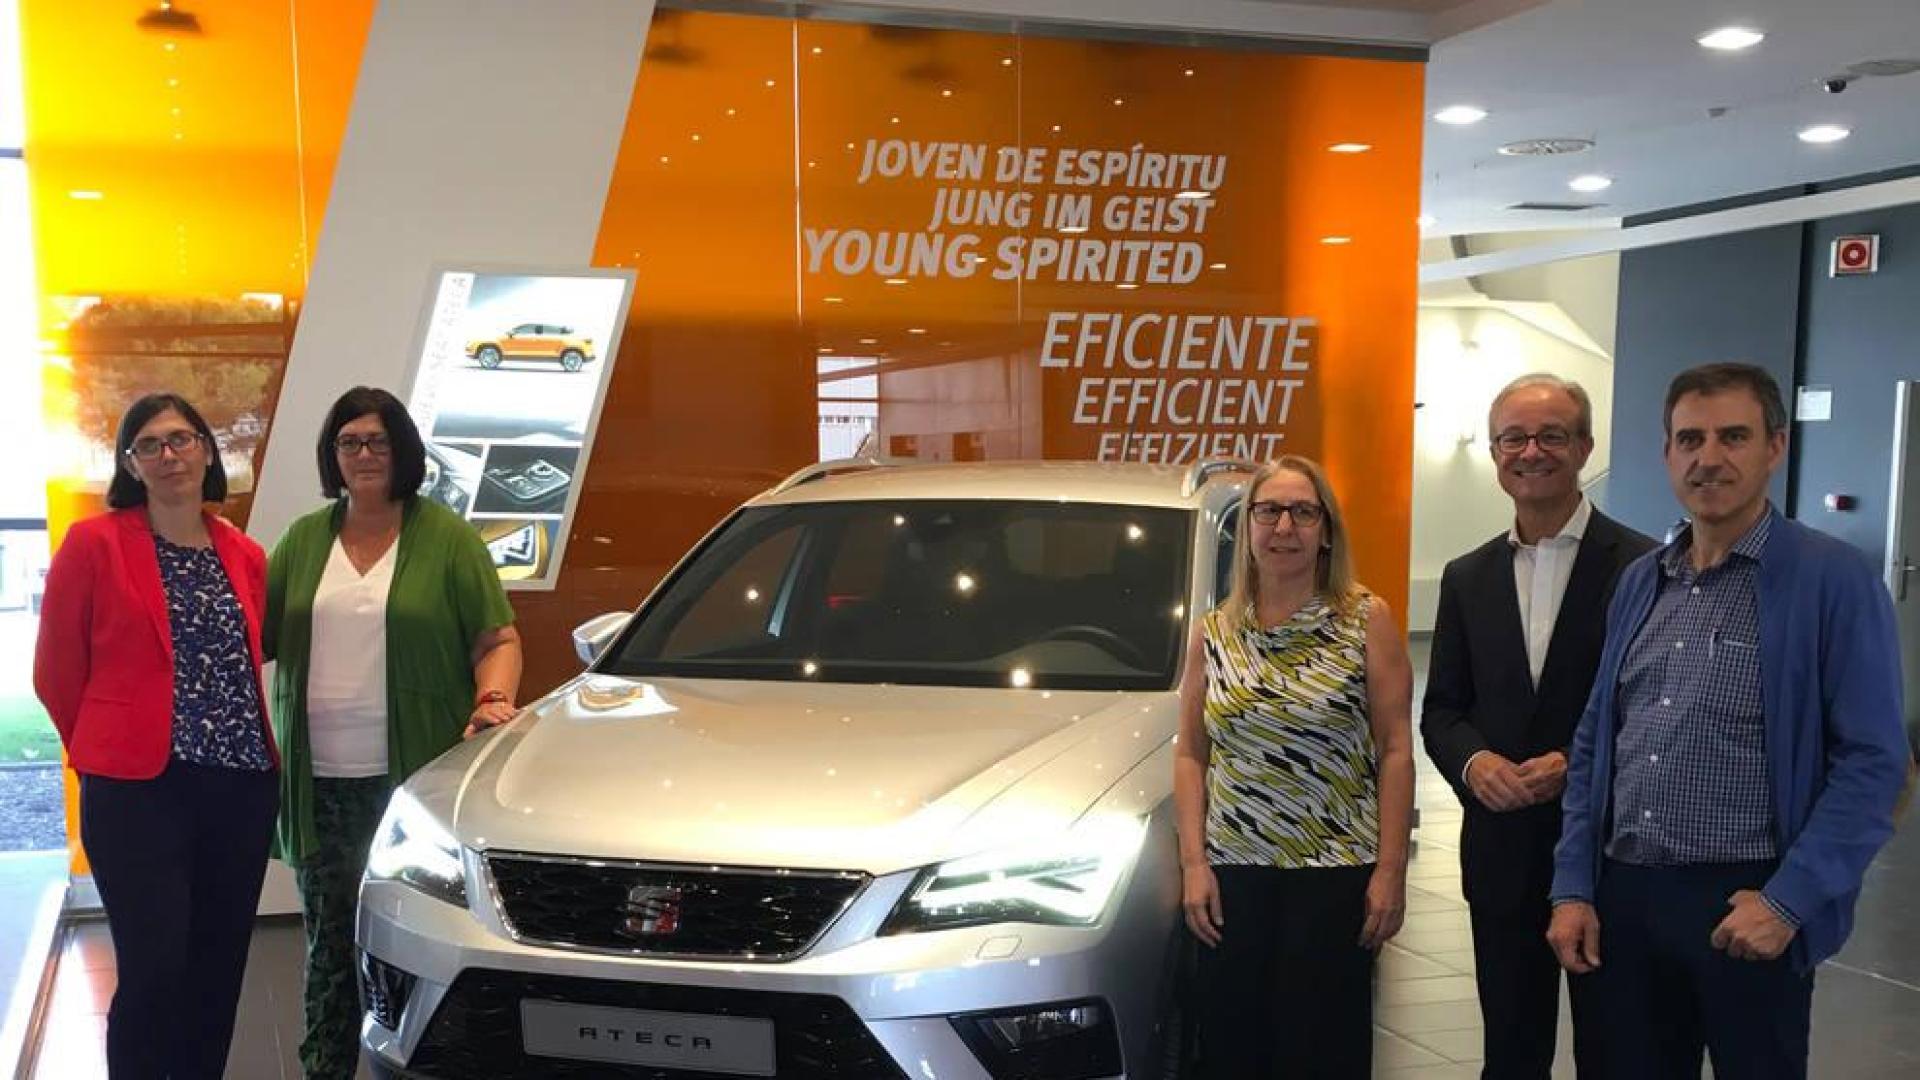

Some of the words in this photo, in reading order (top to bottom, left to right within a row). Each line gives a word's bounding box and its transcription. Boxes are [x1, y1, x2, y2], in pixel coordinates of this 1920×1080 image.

[858, 139, 988, 184] JOVEN
[995, 146, 1048, 184] DE
[1055, 143, 1226, 191] ESPÍRITU
[929, 188, 1032, 231] JUNG
[1043, 193, 1092, 232] IM
[1103, 197, 1216, 235] GEIST
[804, 228, 981, 277] YOUNG
[994, 238, 1204, 284] SPIRITED
[1039, 311, 1318, 371] EFICIENTE
[1073, 377, 1304, 424] EFFICIENT
[1098, 433, 1284, 465] EFFIZIENT
[579, 1027, 712, 1049] ATECA
